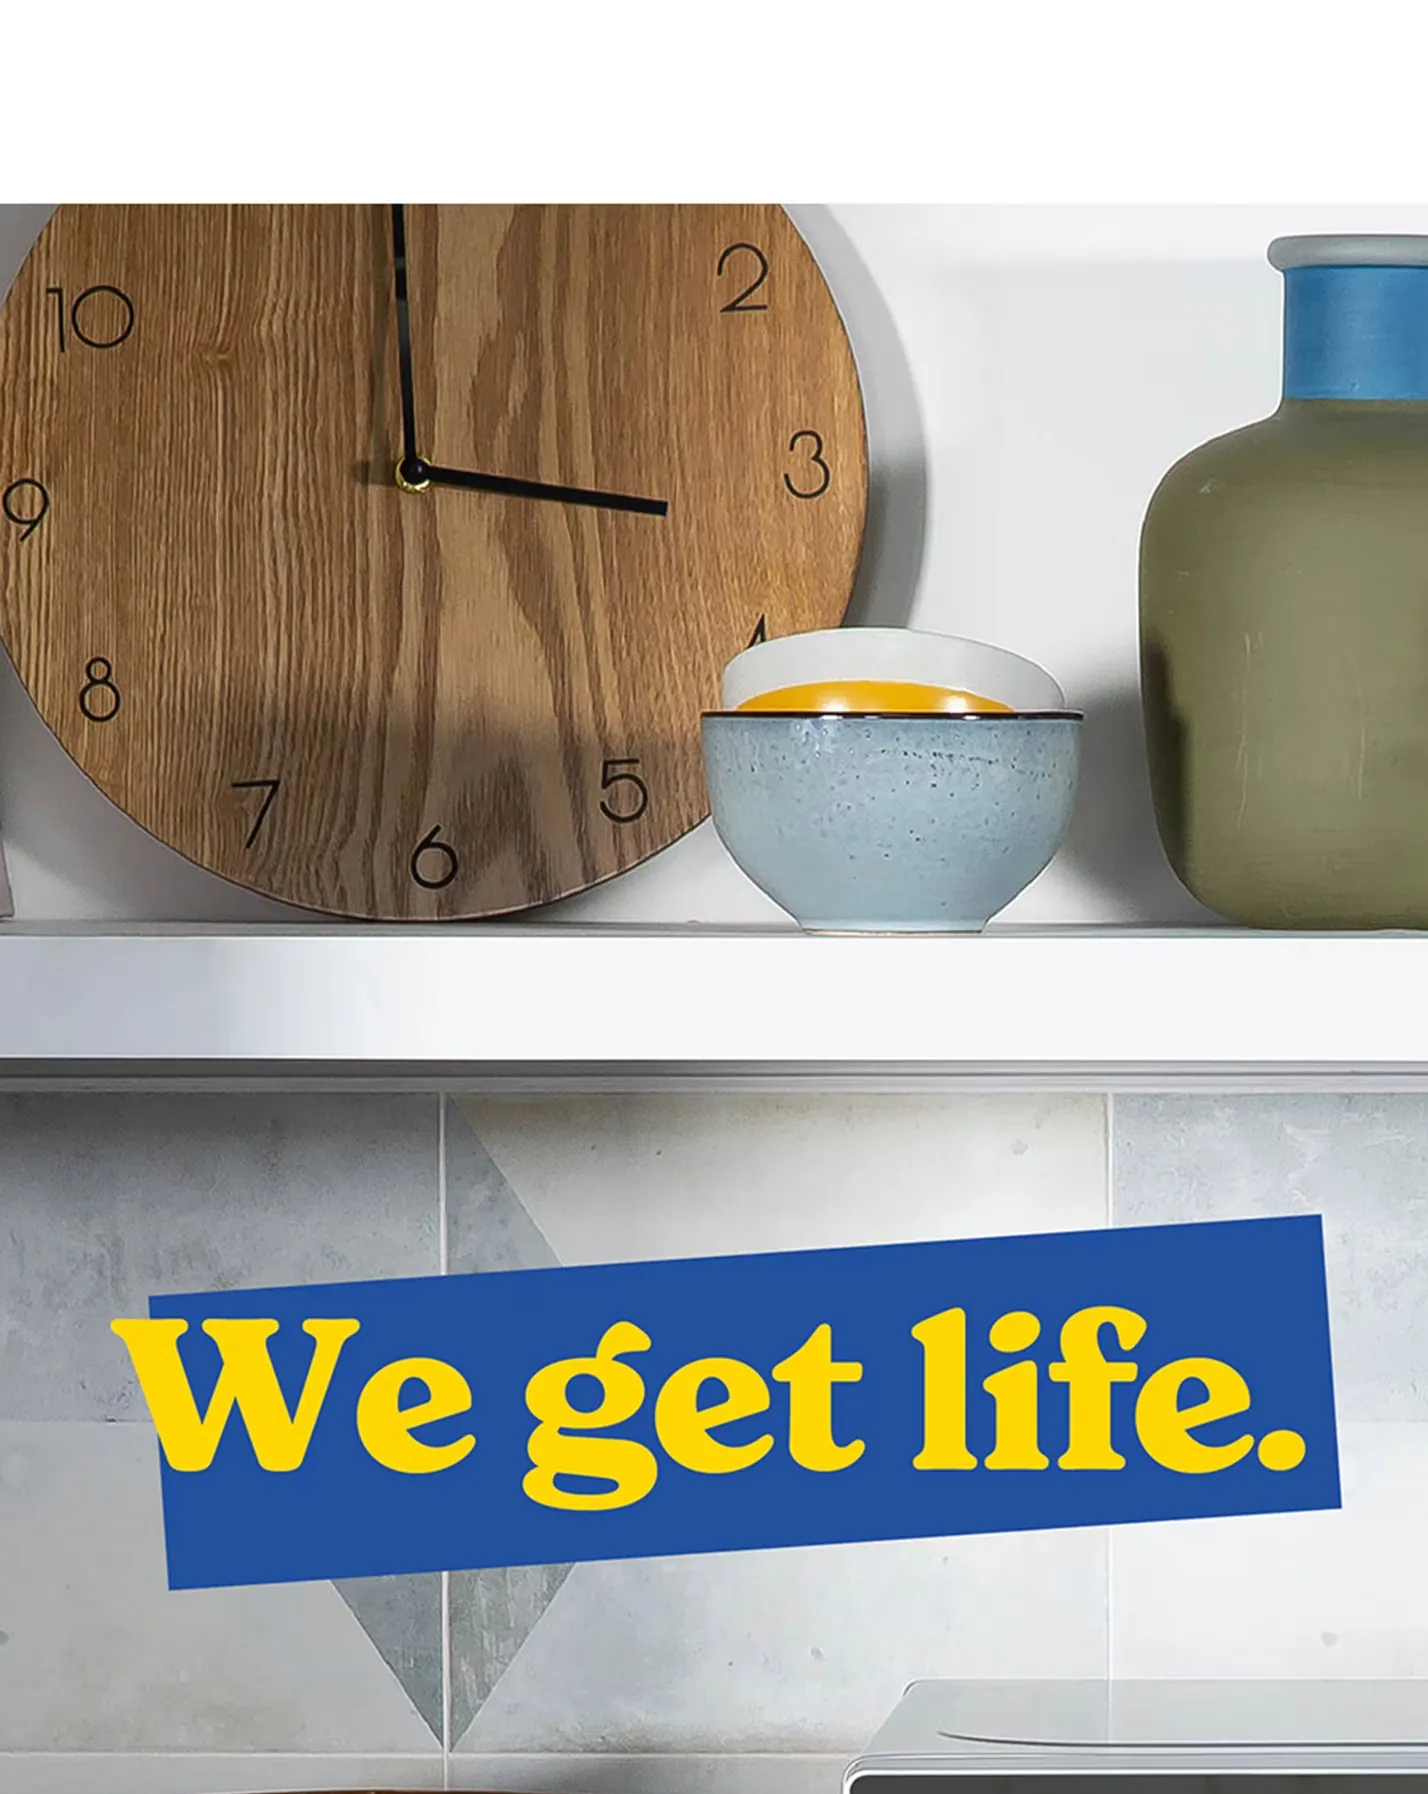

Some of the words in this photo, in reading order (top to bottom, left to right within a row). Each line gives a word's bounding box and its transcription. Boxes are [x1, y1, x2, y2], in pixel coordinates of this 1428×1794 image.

[718, 243, 768, 312] 2
[46, 285, 135, 353] 10
[784, 431, 829, 498] 3
[3, 477, 50, 542] 9
[78, 657, 121, 723] 8
[231, 780, 281, 850] 7
[600, 758, 649, 824] 5
[410, 825, 459, 891] 6
